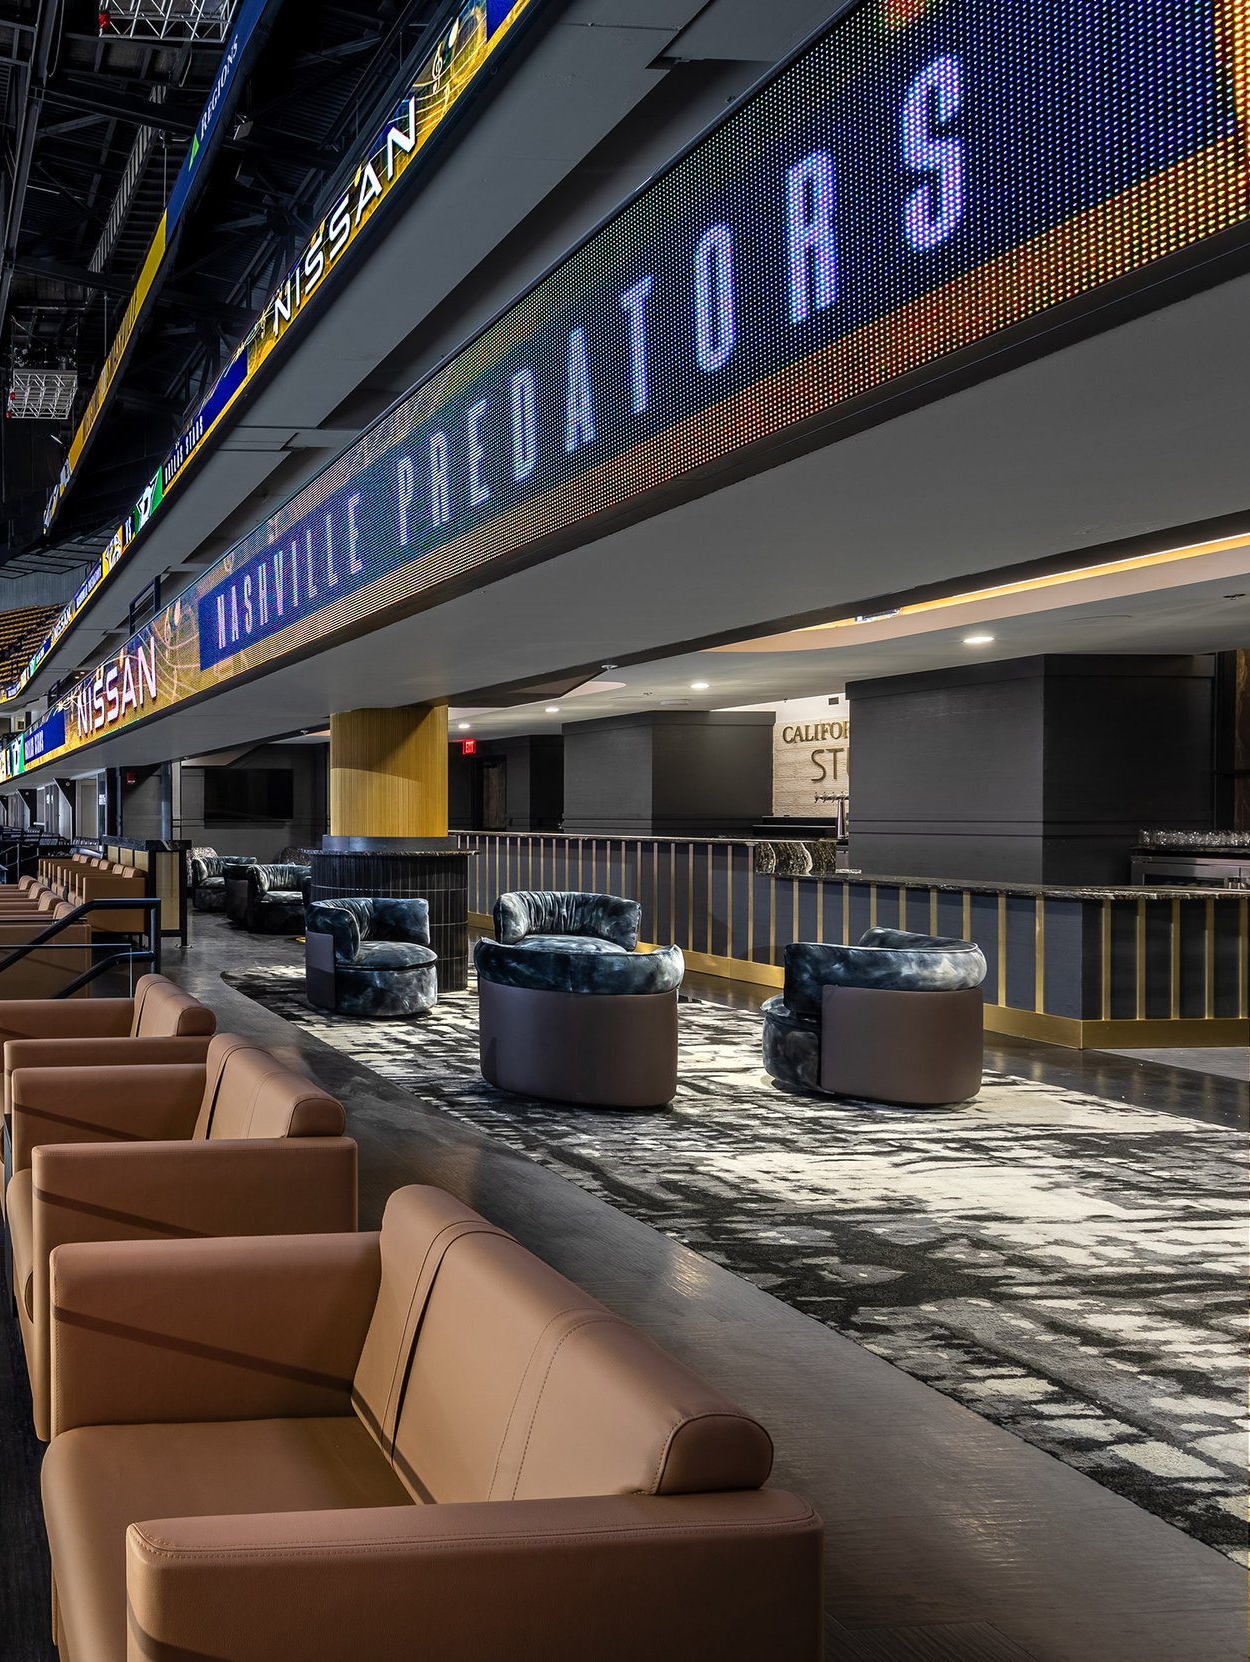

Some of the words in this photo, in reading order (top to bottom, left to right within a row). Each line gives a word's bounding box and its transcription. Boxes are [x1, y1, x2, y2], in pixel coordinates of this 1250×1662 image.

[200, 34, 239, 141] REGIONS
[272, 96, 418, 338] NISSAN
[216, 491, 364, 650] NASHVILLE
[395, 54, 963, 547] PREDATORS
[77, 636, 157, 738] NISSAN
[811, 747, 850, 784] ST
